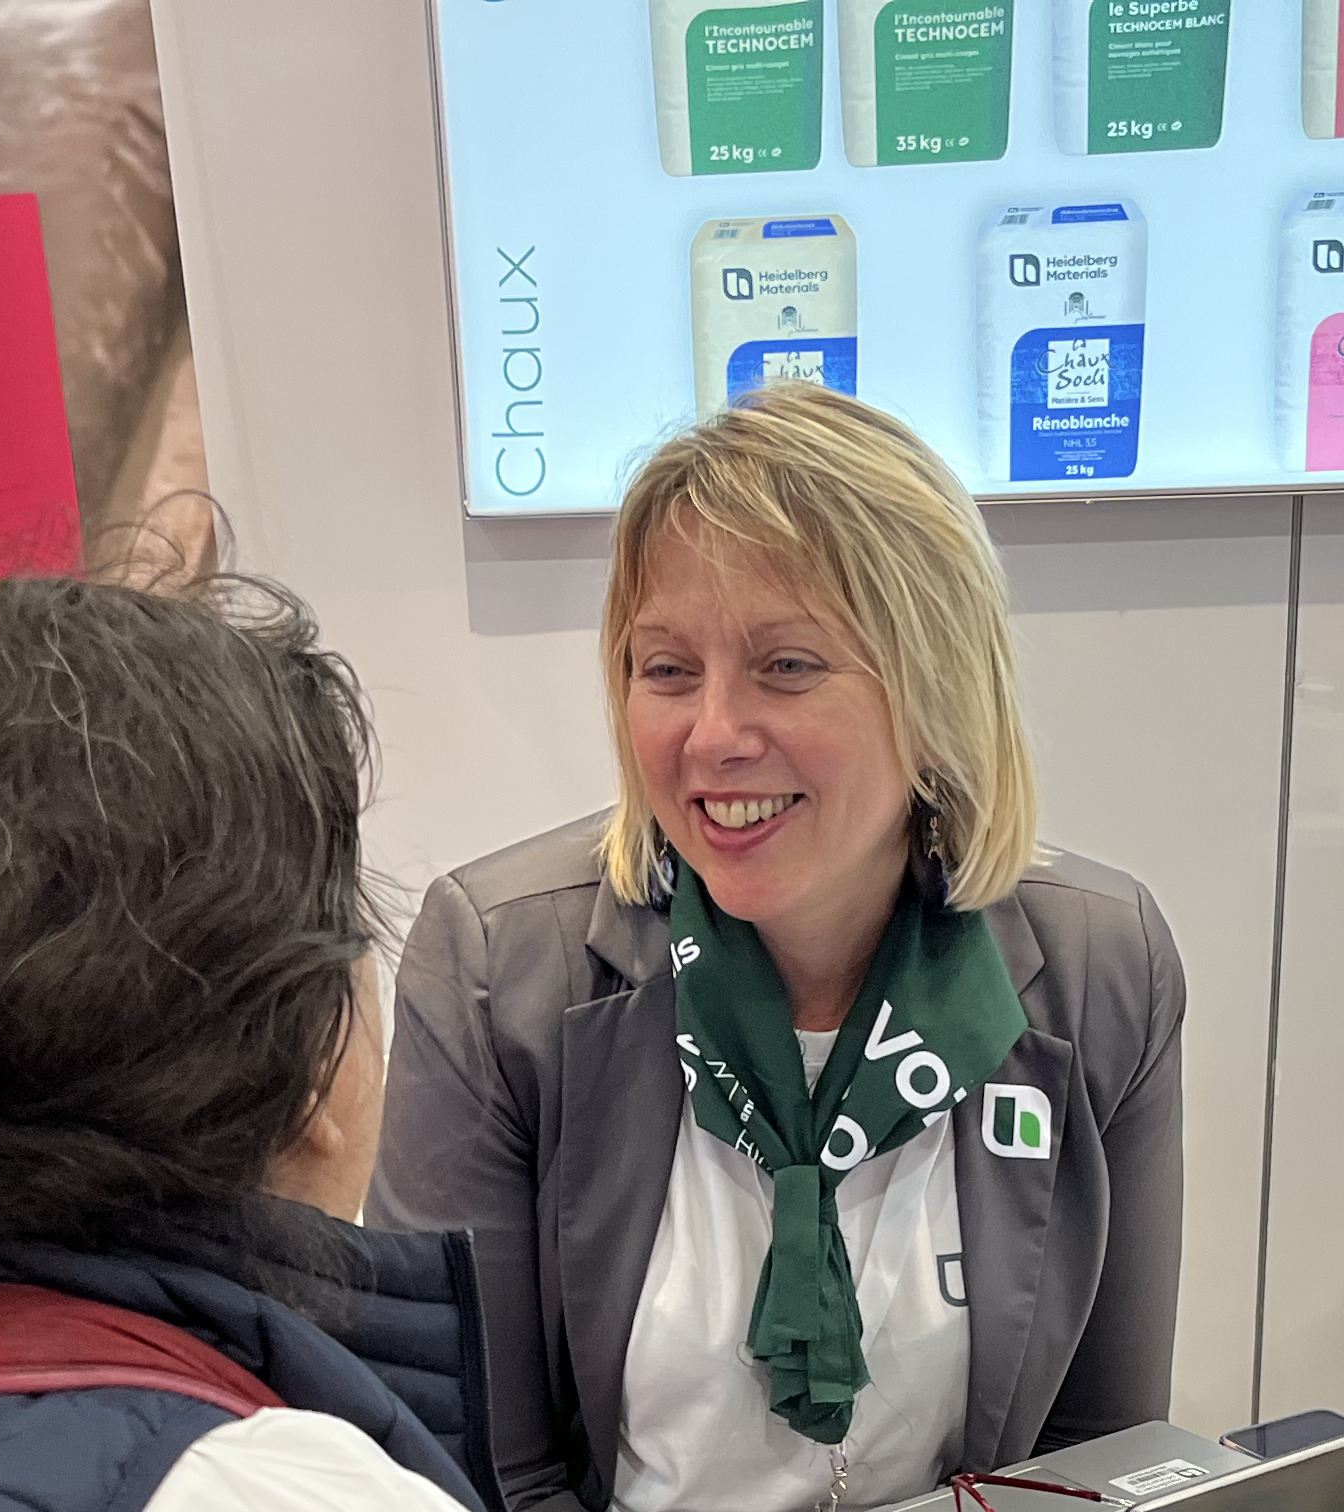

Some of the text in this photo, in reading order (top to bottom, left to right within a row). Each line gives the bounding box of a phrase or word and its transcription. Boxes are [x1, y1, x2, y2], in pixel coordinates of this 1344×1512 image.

[894, 6, 1005, 25] l'Incontournable
[1109, 0, 1199, 17] le Superbe
[705, 17, 814, 37] l'Incontournable
[894, 20, 1005, 43] TECHNOCEM
[1108, 13, 1225, 34] TECHNOCEM BLANC
[705, 32, 814, 54] TECHNOCEM
[1107, 120, 1153, 139] 25 kg
[896, 134, 942, 153] 35 kg
[709, 144, 754, 164] 25 kg
[1046, 254, 1117, 268] Heidelberg
[759, 268, 828, 282] Heidelberg
[1046, 267, 1108, 281] Materials
[759, 281, 819, 295] Materials
[492, 245, 546, 497] Chaux
[1033, 414, 1129, 431] Rénoblanche
[1066, 465, 1094, 476] 25 kg
